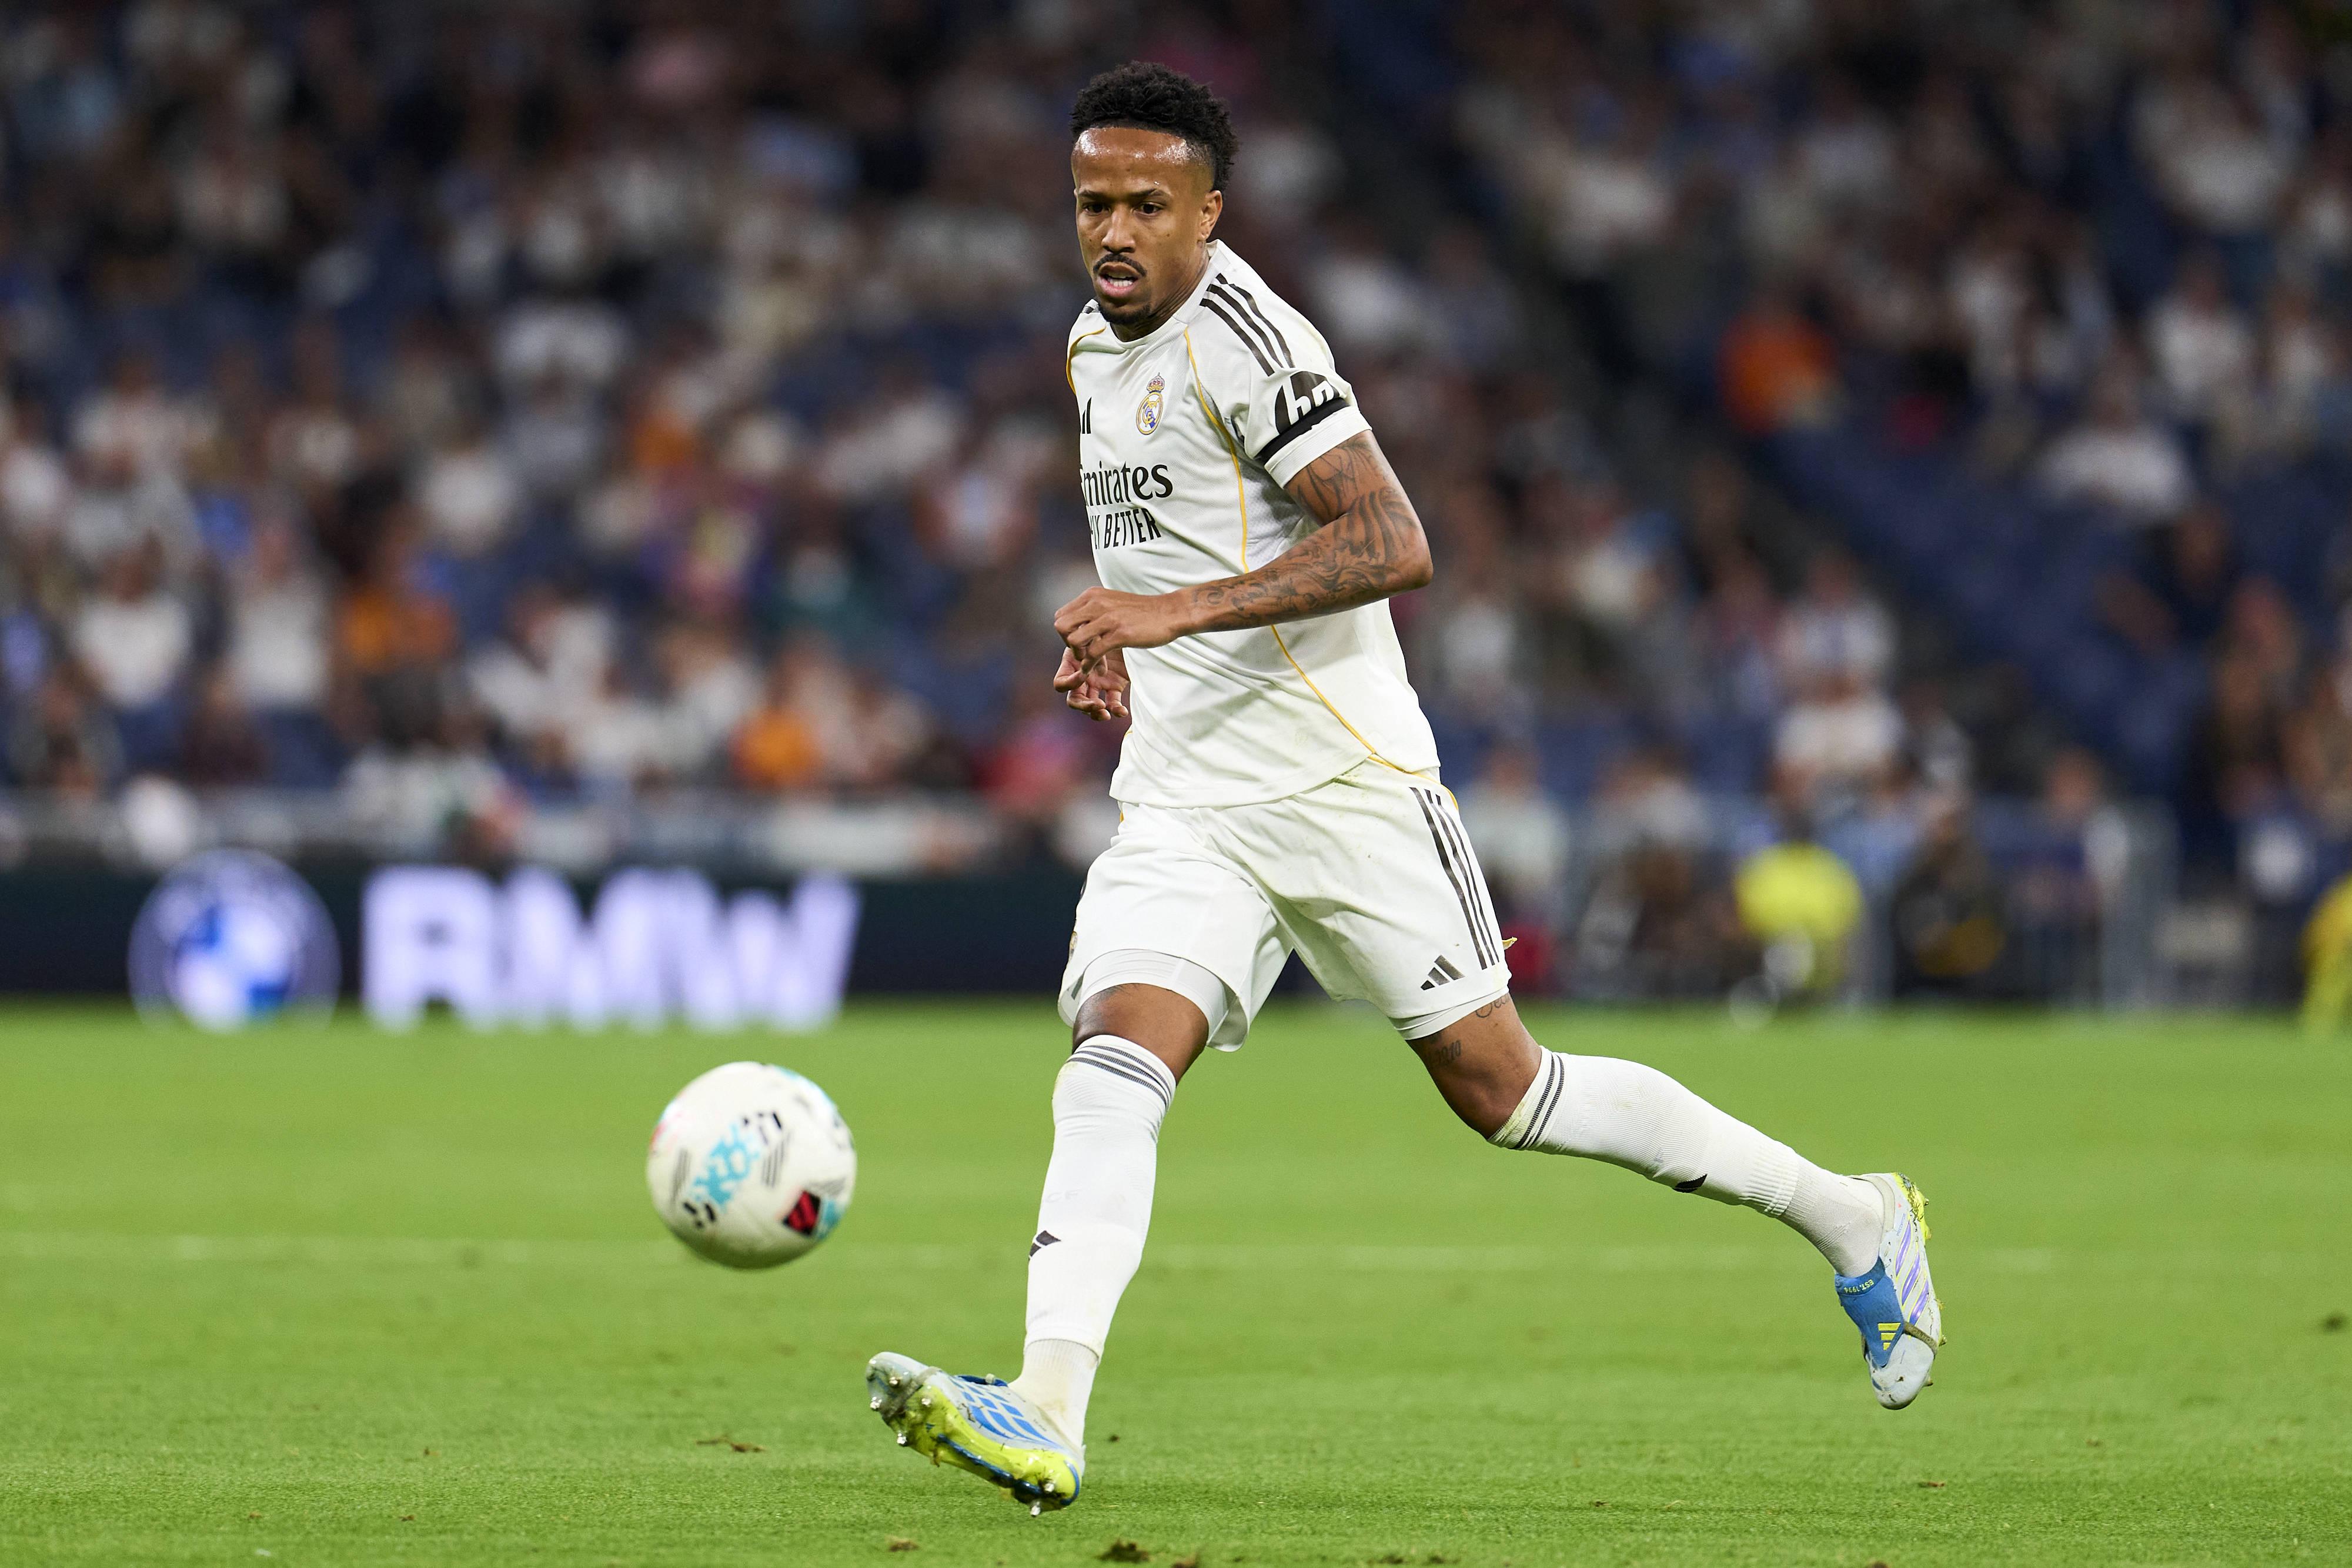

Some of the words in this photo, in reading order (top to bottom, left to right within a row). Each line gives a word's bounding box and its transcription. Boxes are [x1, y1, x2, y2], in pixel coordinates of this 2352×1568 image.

[1080, 460, 1173, 507] mirates
[1090, 515, 1101, 549] LY
[1104, 508, 1161, 549] BETTER
